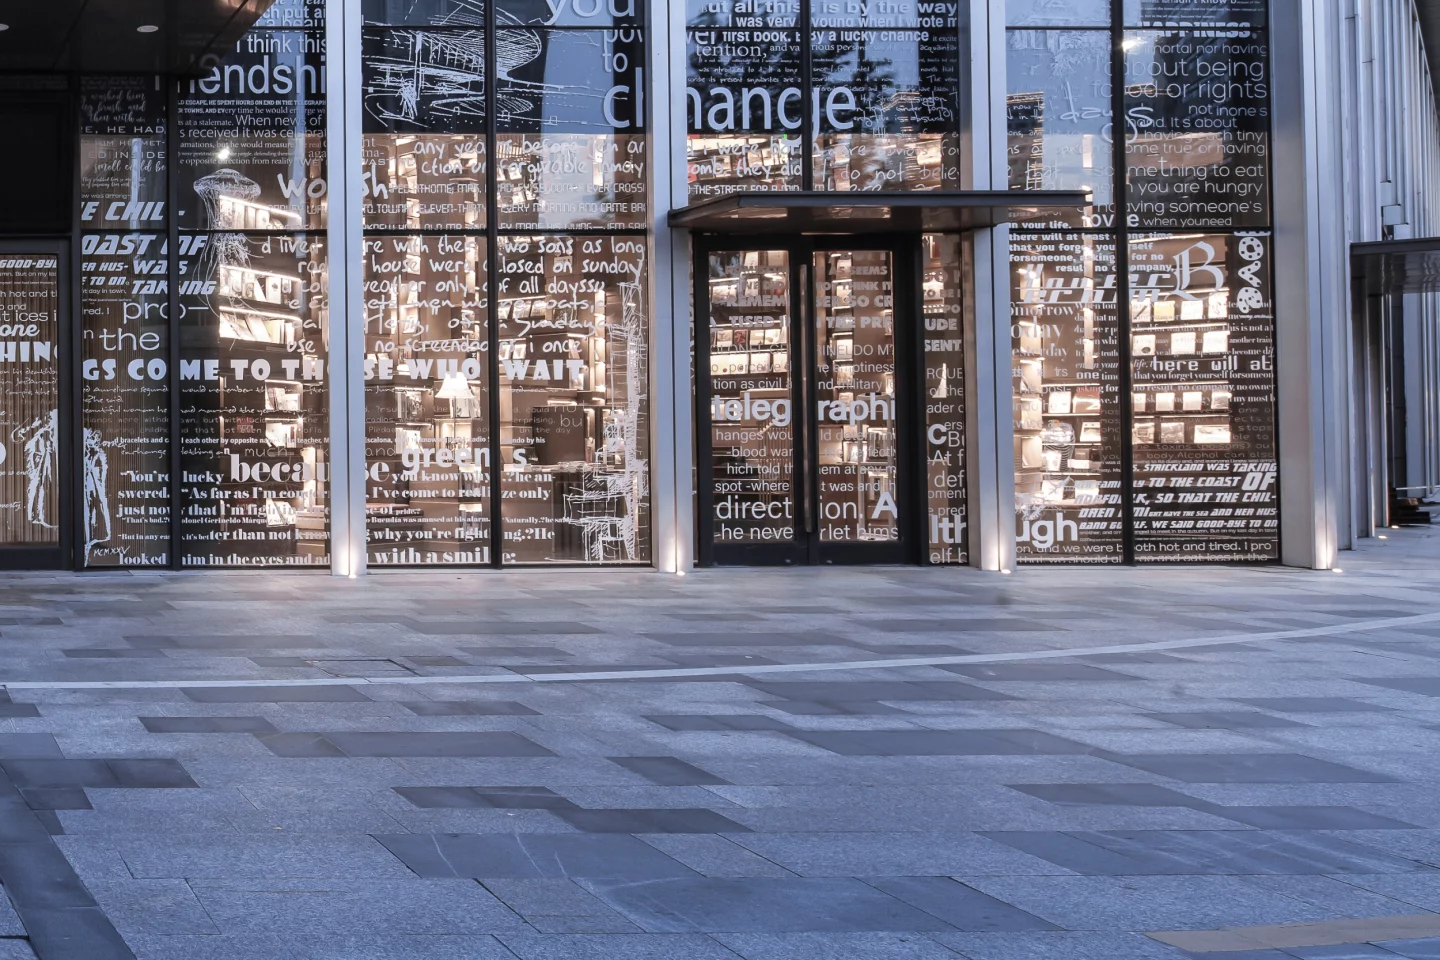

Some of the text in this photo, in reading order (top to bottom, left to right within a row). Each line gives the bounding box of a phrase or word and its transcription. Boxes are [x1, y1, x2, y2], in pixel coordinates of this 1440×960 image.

[735, 1, 957, 15] all by the way
[248, 32, 291, 52] think
[603, 53, 627, 72] to
[1197, 59, 1263, 81] being
[1166, 79, 1266, 102] or rights
[236, 115, 274, 126] When
[1195, 117, 1237, 128] about
[188, 127, 276, 138] received it was
[1236, 130, 1263, 142] tiny
[414, 143, 454, 159] any
[187, 158, 216, 166] opposite
[1213, 165, 1263, 176] to eat
[1138, 181, 1262, 195] you are hungry
[1143, 216, 1176, 226] when
[610, 240, 645, 259] long
[372, 259, 420, 273] house
[435, 280, 538, 294] only all
[99, 329, 160, 350] the
[231, 360, 270, 380] TO
[410, 359, 583, 380] WHO WAIT
[1212, 356, 1237, 370] will
[758, 378, 782, 389] civil
[1233, 463, 1277, 472] TAKING
[183, 471, 224, 483] lucky
[1170, 473, 1277, 489] THE COAST OF
[211, 488, 231, 499] far
[519, 487, 550, 499] only
[715, 481, 742, 492] spot
[1177, 493, 1239, 503] THAT THE
[722, 525, 745, 539] he
[829, 525, 850, 539] let
[1159, 542, 1180, 552] hot
[210, 554, 310, 566] in the eyes and
[375, 547, 420, 563] with
